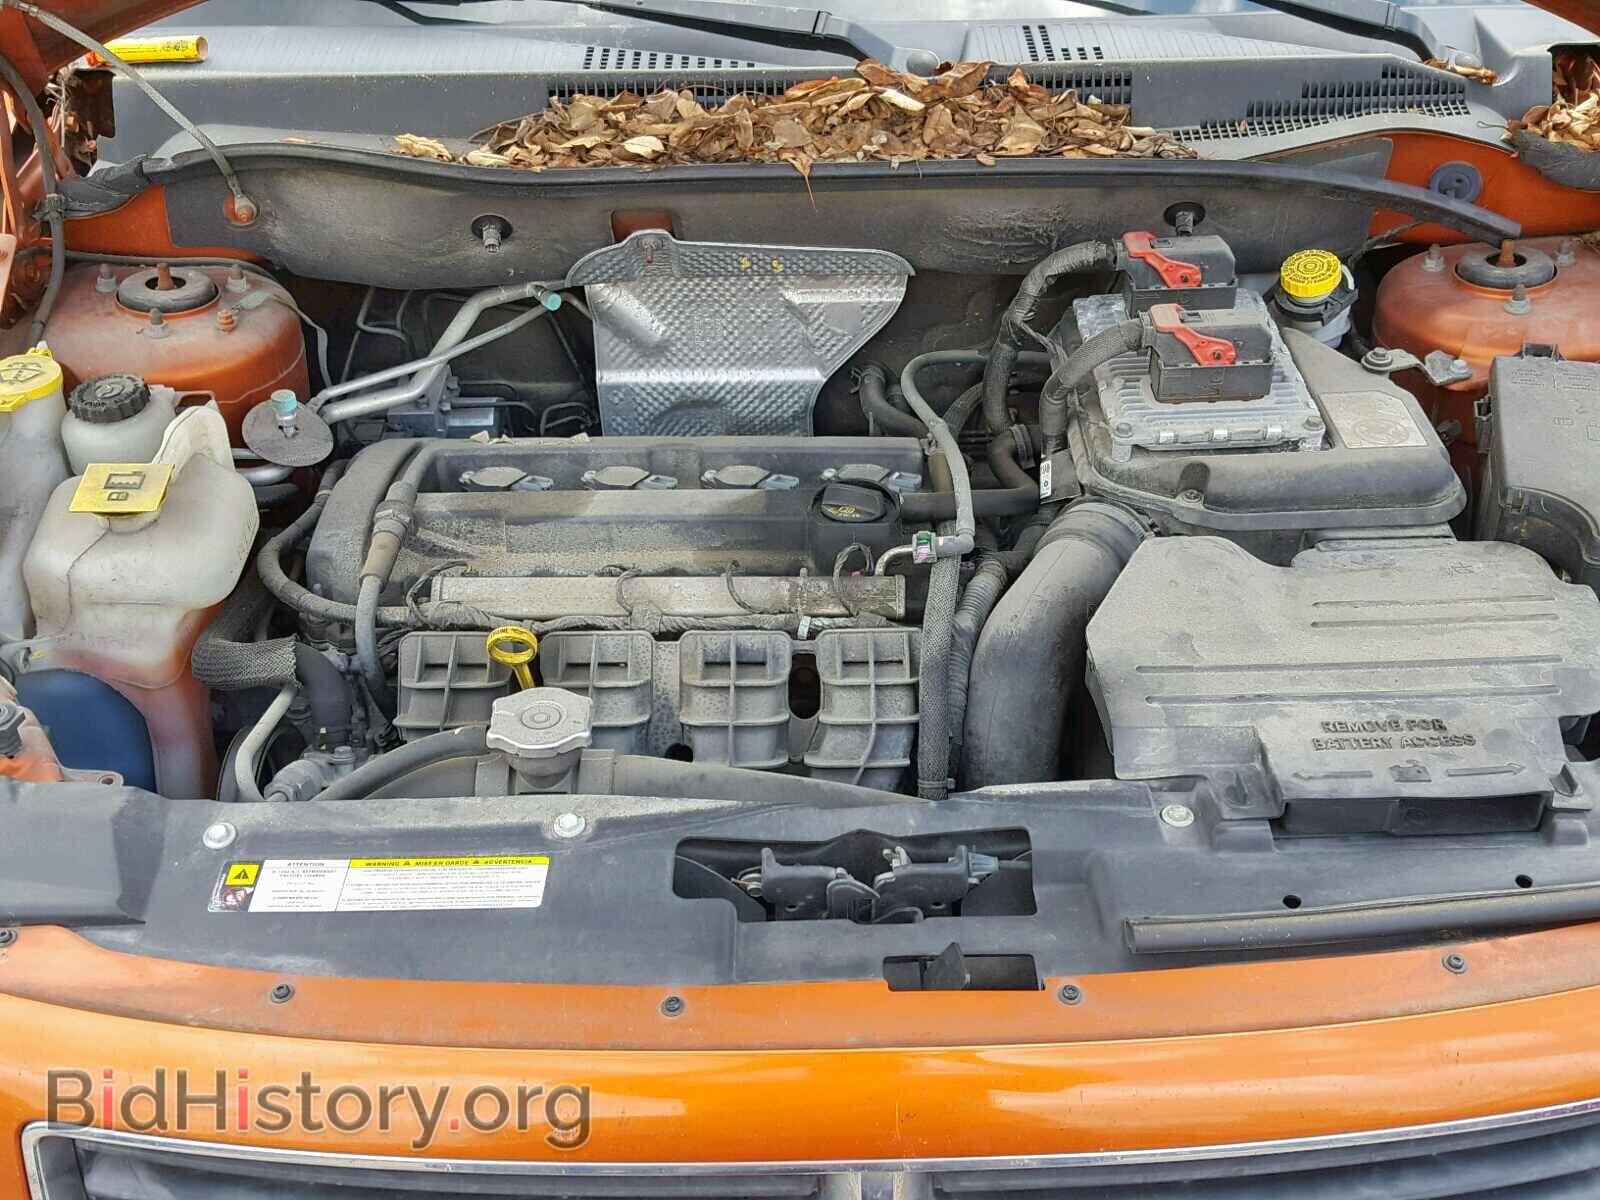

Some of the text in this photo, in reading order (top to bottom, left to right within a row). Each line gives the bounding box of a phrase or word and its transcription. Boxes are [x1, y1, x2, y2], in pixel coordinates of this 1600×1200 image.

[1321, 718, 1448, 733] REMOVE FOR
[1312, 734, 1476, 751] BATTERY ACCESS
